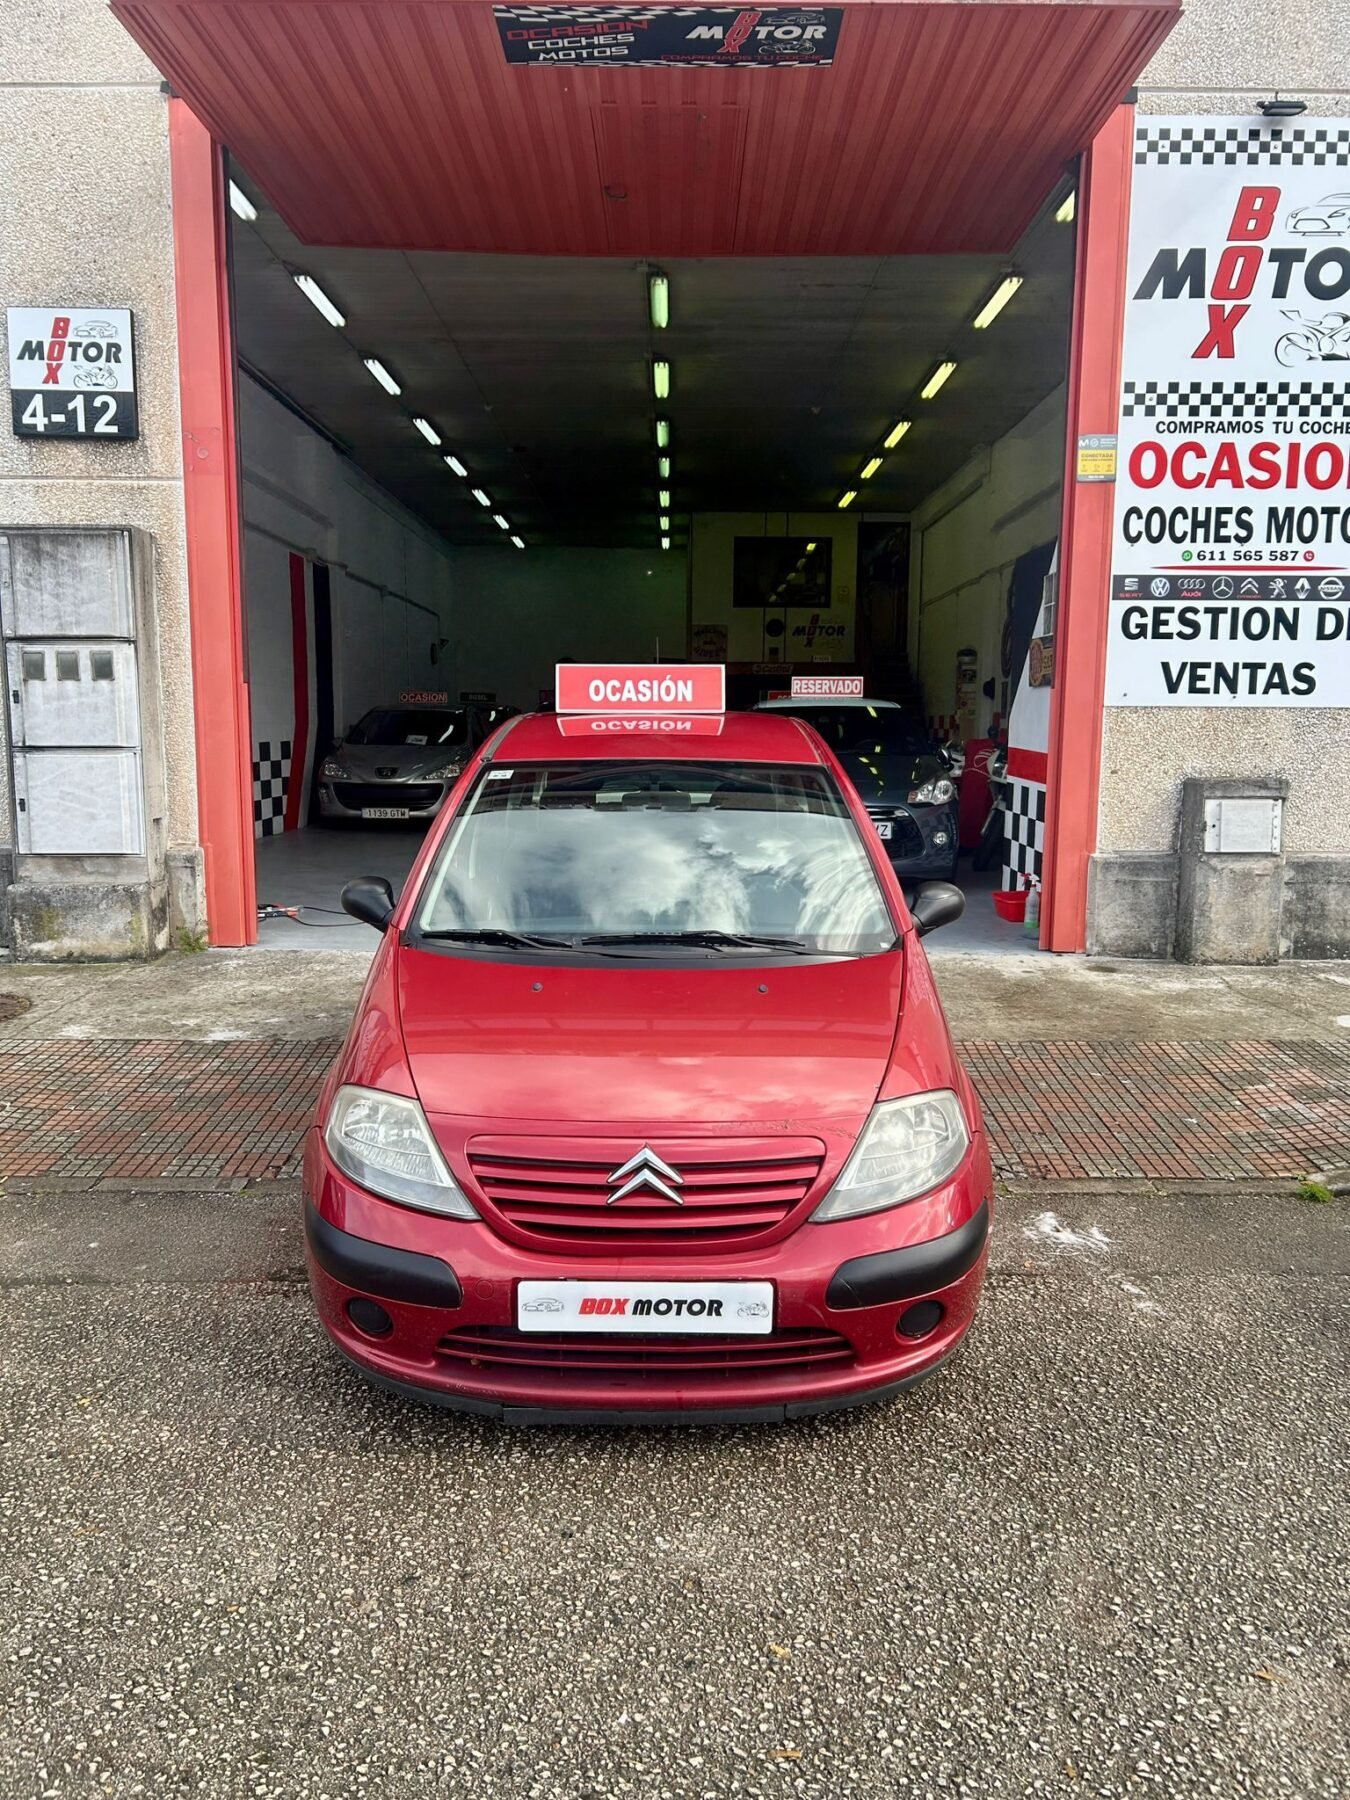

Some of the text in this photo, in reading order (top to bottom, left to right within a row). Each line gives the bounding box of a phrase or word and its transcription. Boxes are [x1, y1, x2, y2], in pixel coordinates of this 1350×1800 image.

[507, 20, 648, 40] OCASION
[528, 32, 635, 50] COCHES
[685, 25, 827, 40] MOTOR
[716, 11, 762, 53] BOX
[538, 45, 629, 61] MOTOS
[1191, 186, 1281, 359] BOX
[17, 339, 122, 363] MOTOR
[42, 317, 71, 385] BOX
[22, 393, 119, 433] 4-12
[1155, 420, 1264, 434] COMPRAMOS
[1272, 421, 1294, 434] TU
[1128, 440, 1350, 490] OCASIO
[1122, 506, 1254, 544] COCHES
[1197, 550, 1299, 562] 611 565 587
[1180, 590, 1202, 598] Audi
[1121, 606, 1350, 641] GESTION D
[589, 675, 693, 702] OCASIÓN
[793, 679, 861, 694] RESERVADO
[1161, 661, 1316, 696] VENTAS
[367, 809, 406, 818] 1139 GTM
[578, 1298, 722, 1316] BOX MOTOR
